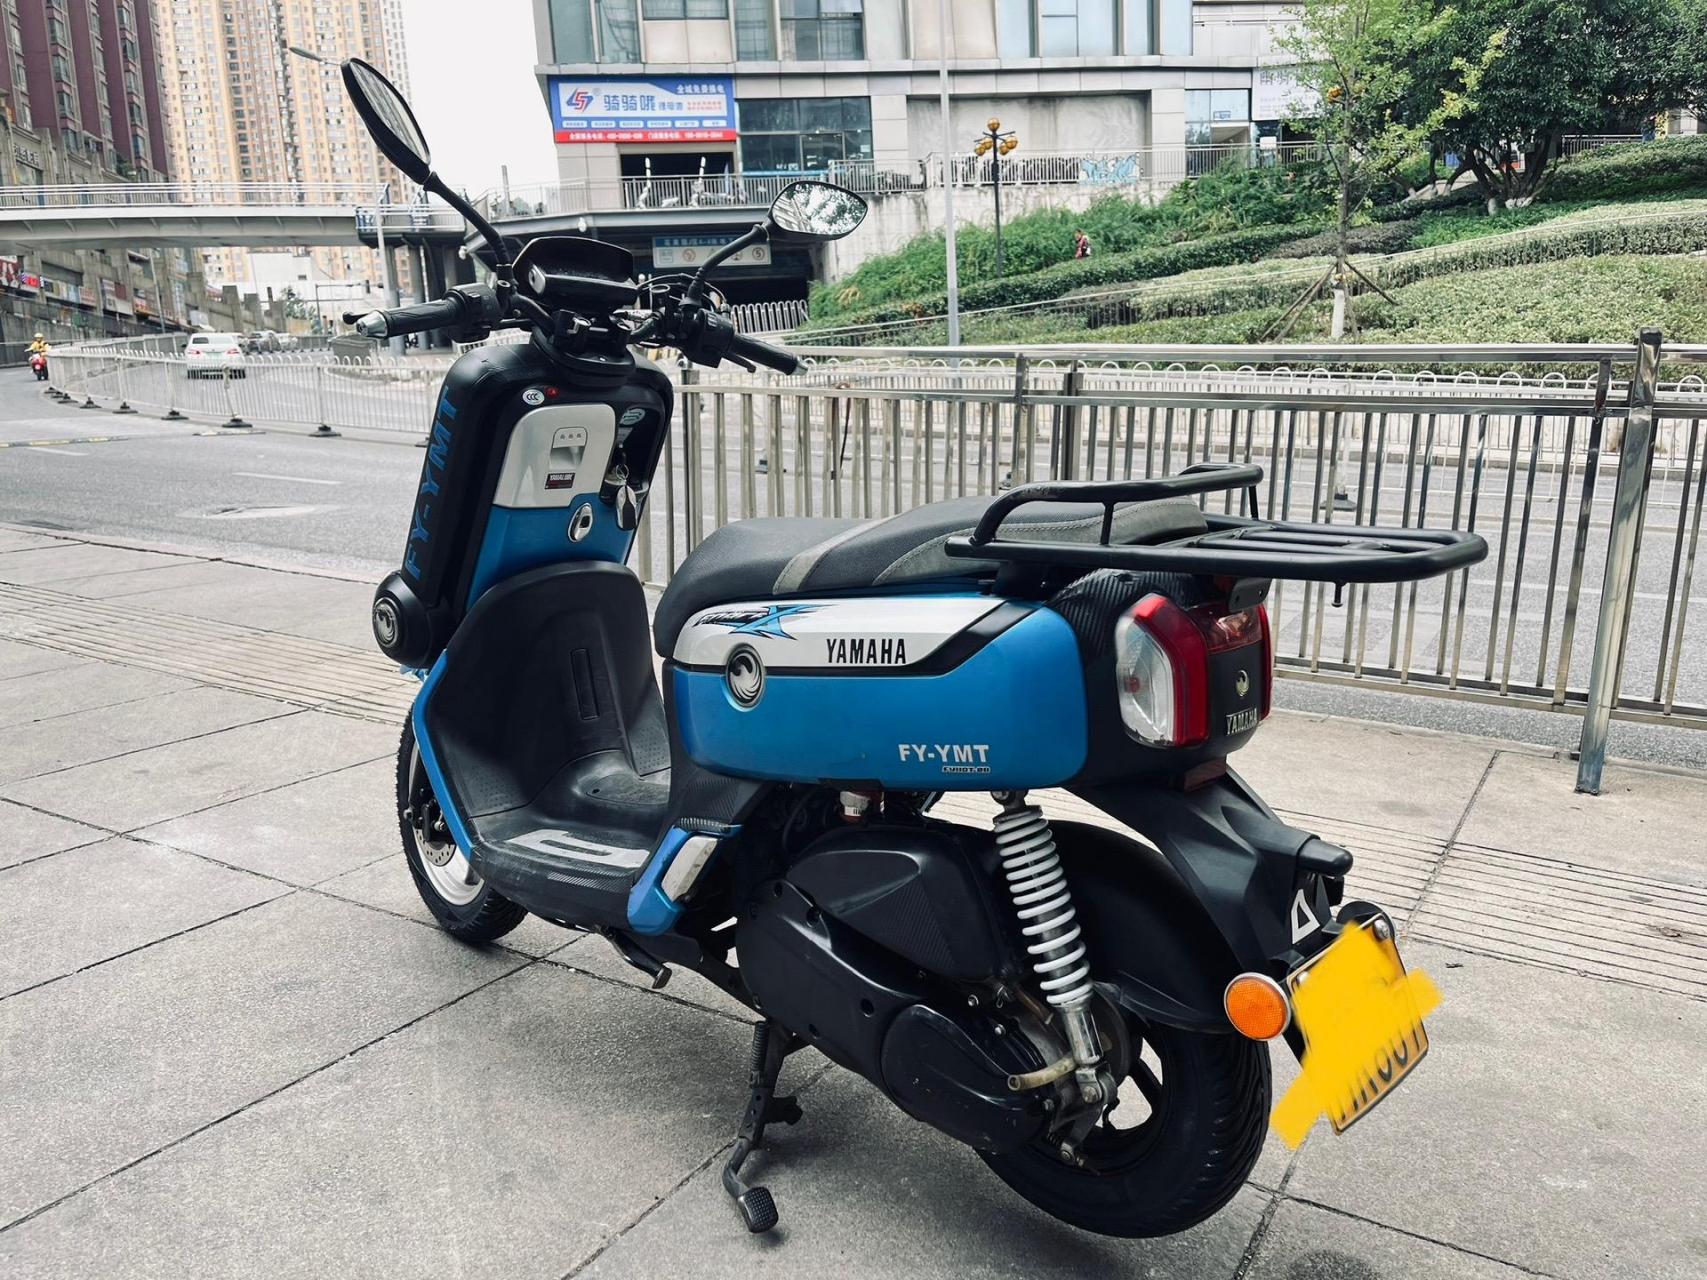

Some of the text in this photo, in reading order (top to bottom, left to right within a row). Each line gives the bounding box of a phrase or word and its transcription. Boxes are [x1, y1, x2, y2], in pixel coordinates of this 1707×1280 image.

[526, 393, 539, 401] CCC
[404, 384, 457, 581] FY-YMT
[827, 638, 907, 665] YAMAHA
[1225, 707, 1258, 736] YAMAHA
[898, 744, 989, 763] FY-YMT
